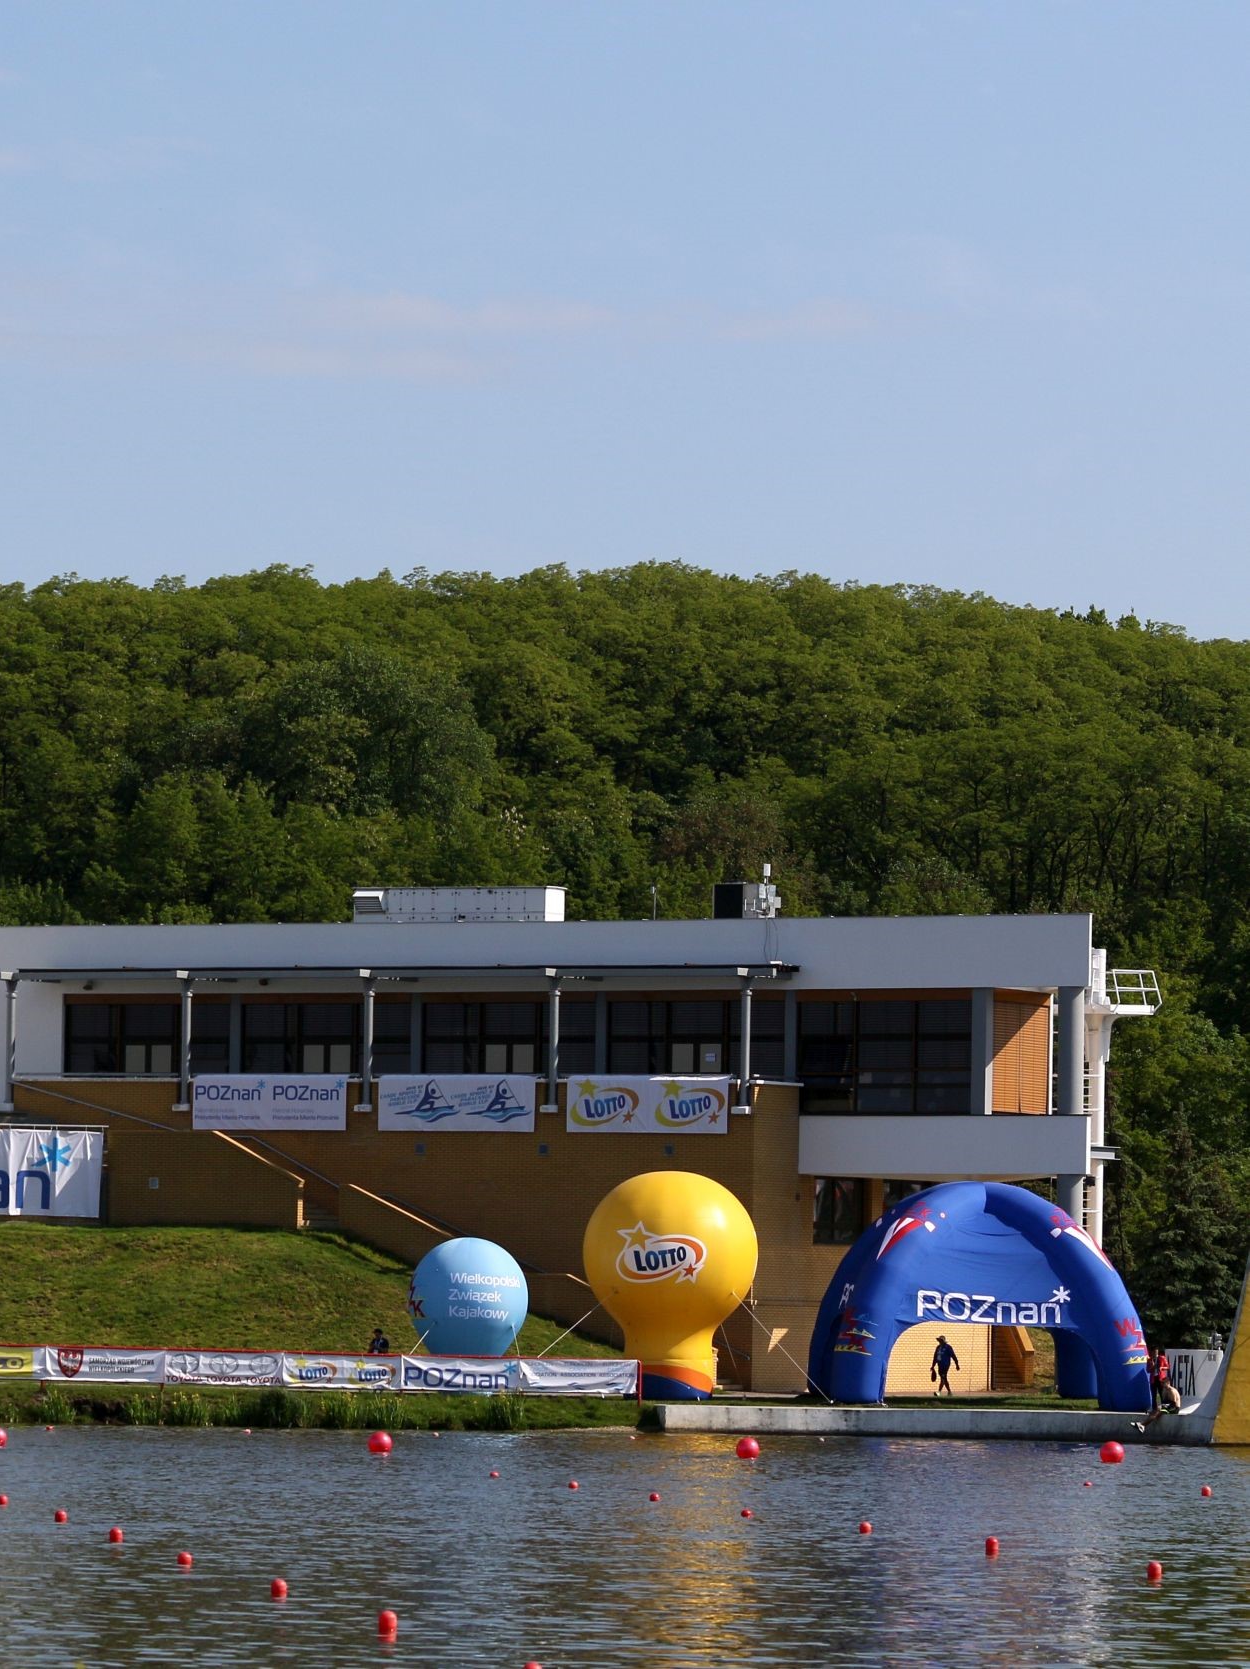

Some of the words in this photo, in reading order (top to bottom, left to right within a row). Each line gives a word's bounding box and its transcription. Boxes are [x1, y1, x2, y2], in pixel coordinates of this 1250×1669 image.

[584, 1094, 625, 1119] LOTTO
[669, 1094, 711, 1119] LOTTO
[634, 1246, 687, 1271] LOTTO
[448, 1289, 502, 1303] Związek
[449, 1305, 509, 1321] Kajakowy
[206, 1375, 241, 1383] TOYOTA
[245, 1376, 281, 1384] TOYOTA
[299, 1366, 328, 1380] LOTTO
[359, 1368, 387, 1381] LOTTO
